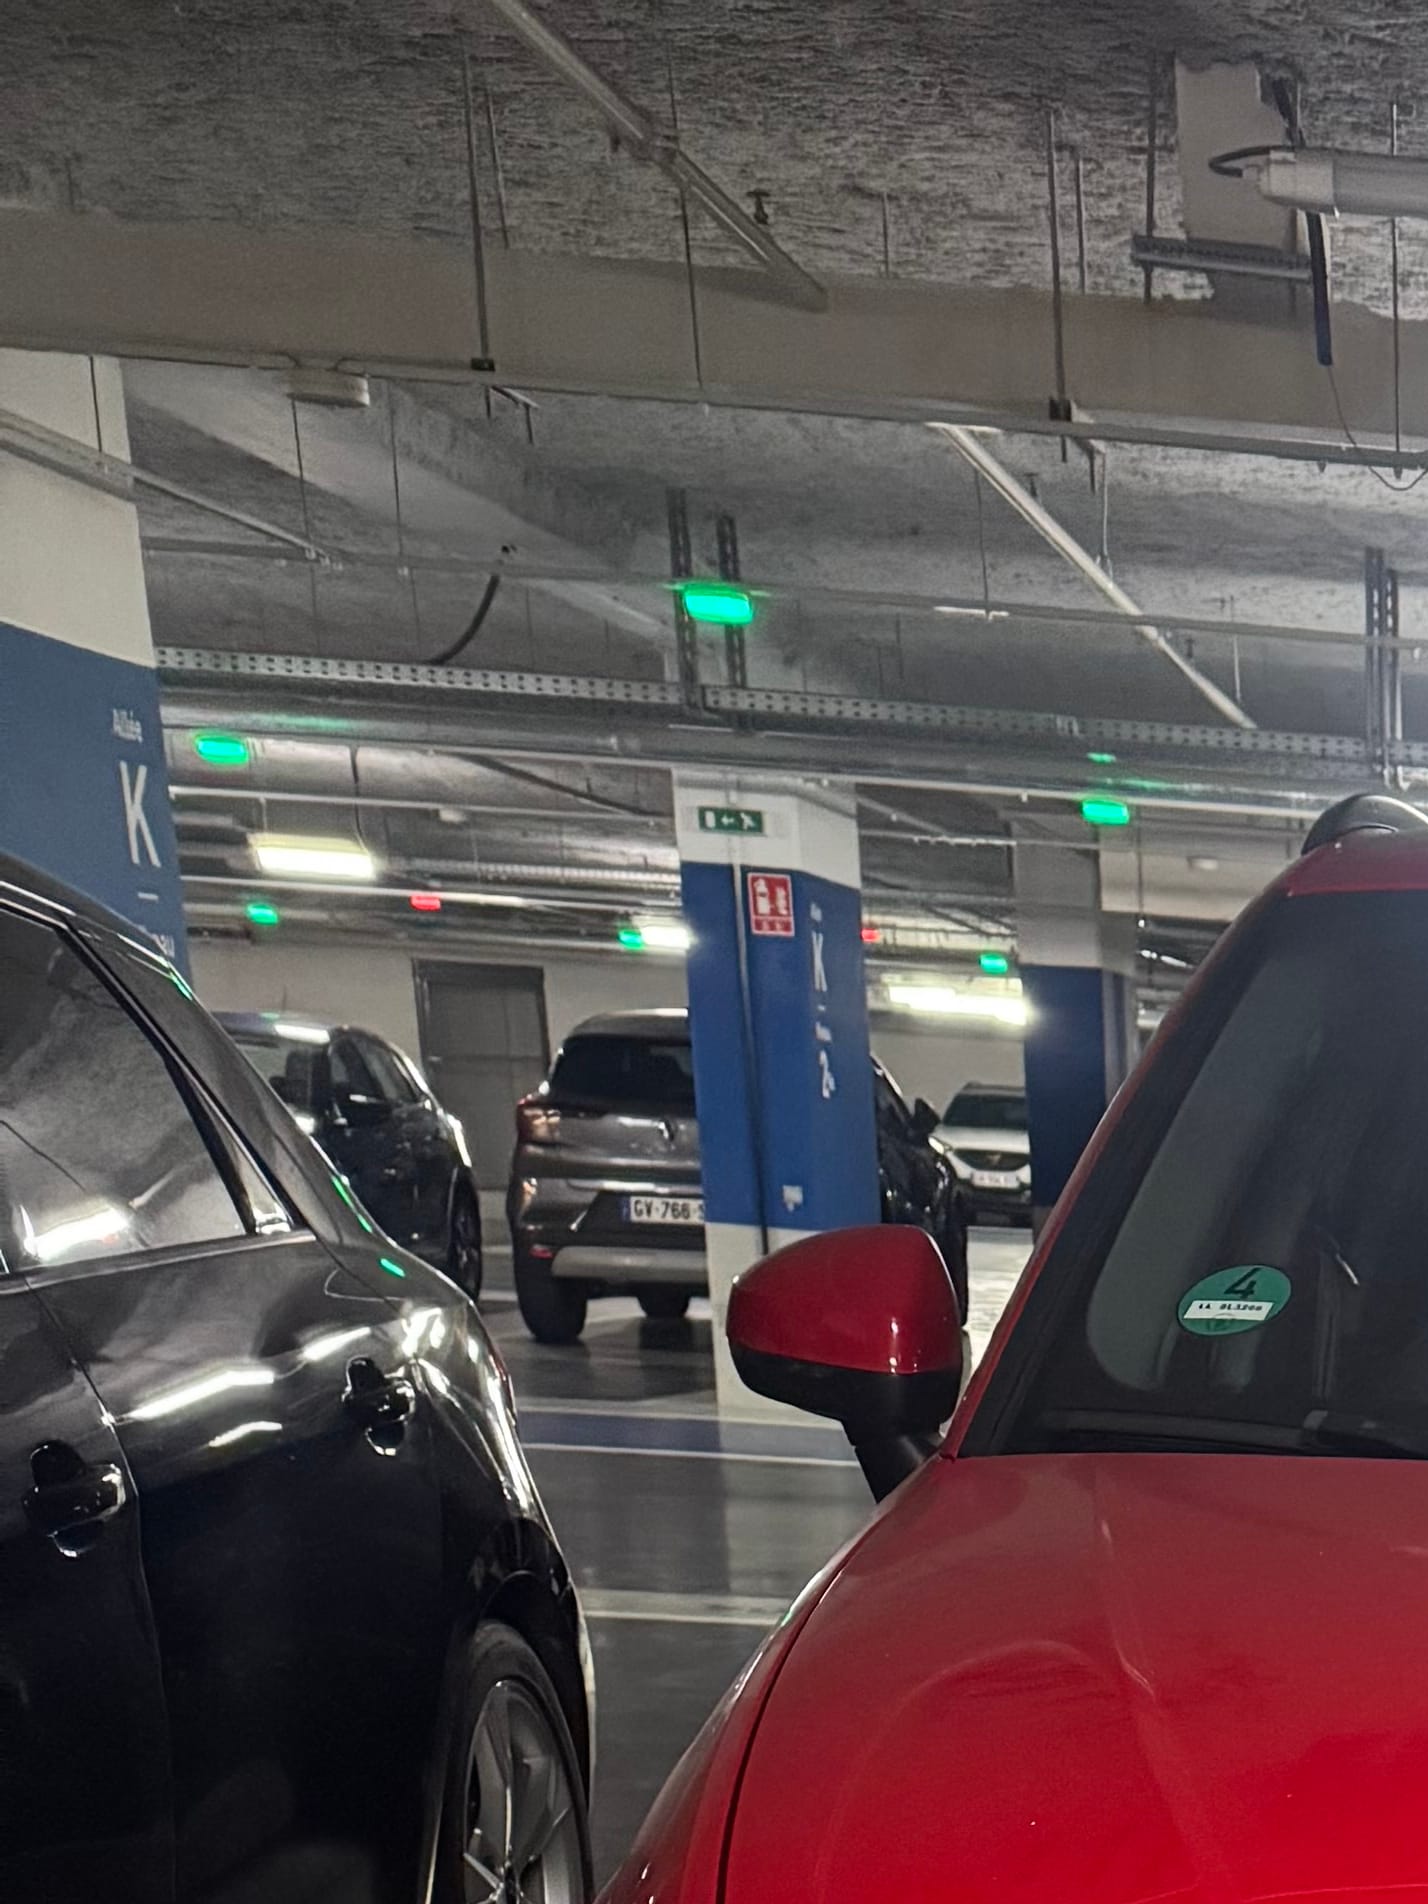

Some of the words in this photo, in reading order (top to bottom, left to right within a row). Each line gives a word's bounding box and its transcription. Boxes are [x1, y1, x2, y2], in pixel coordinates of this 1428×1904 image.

[120, 760, 161, 868] K
[811, 930, 828, 992] K
[1223, 1267, 1263, 1299] 4
